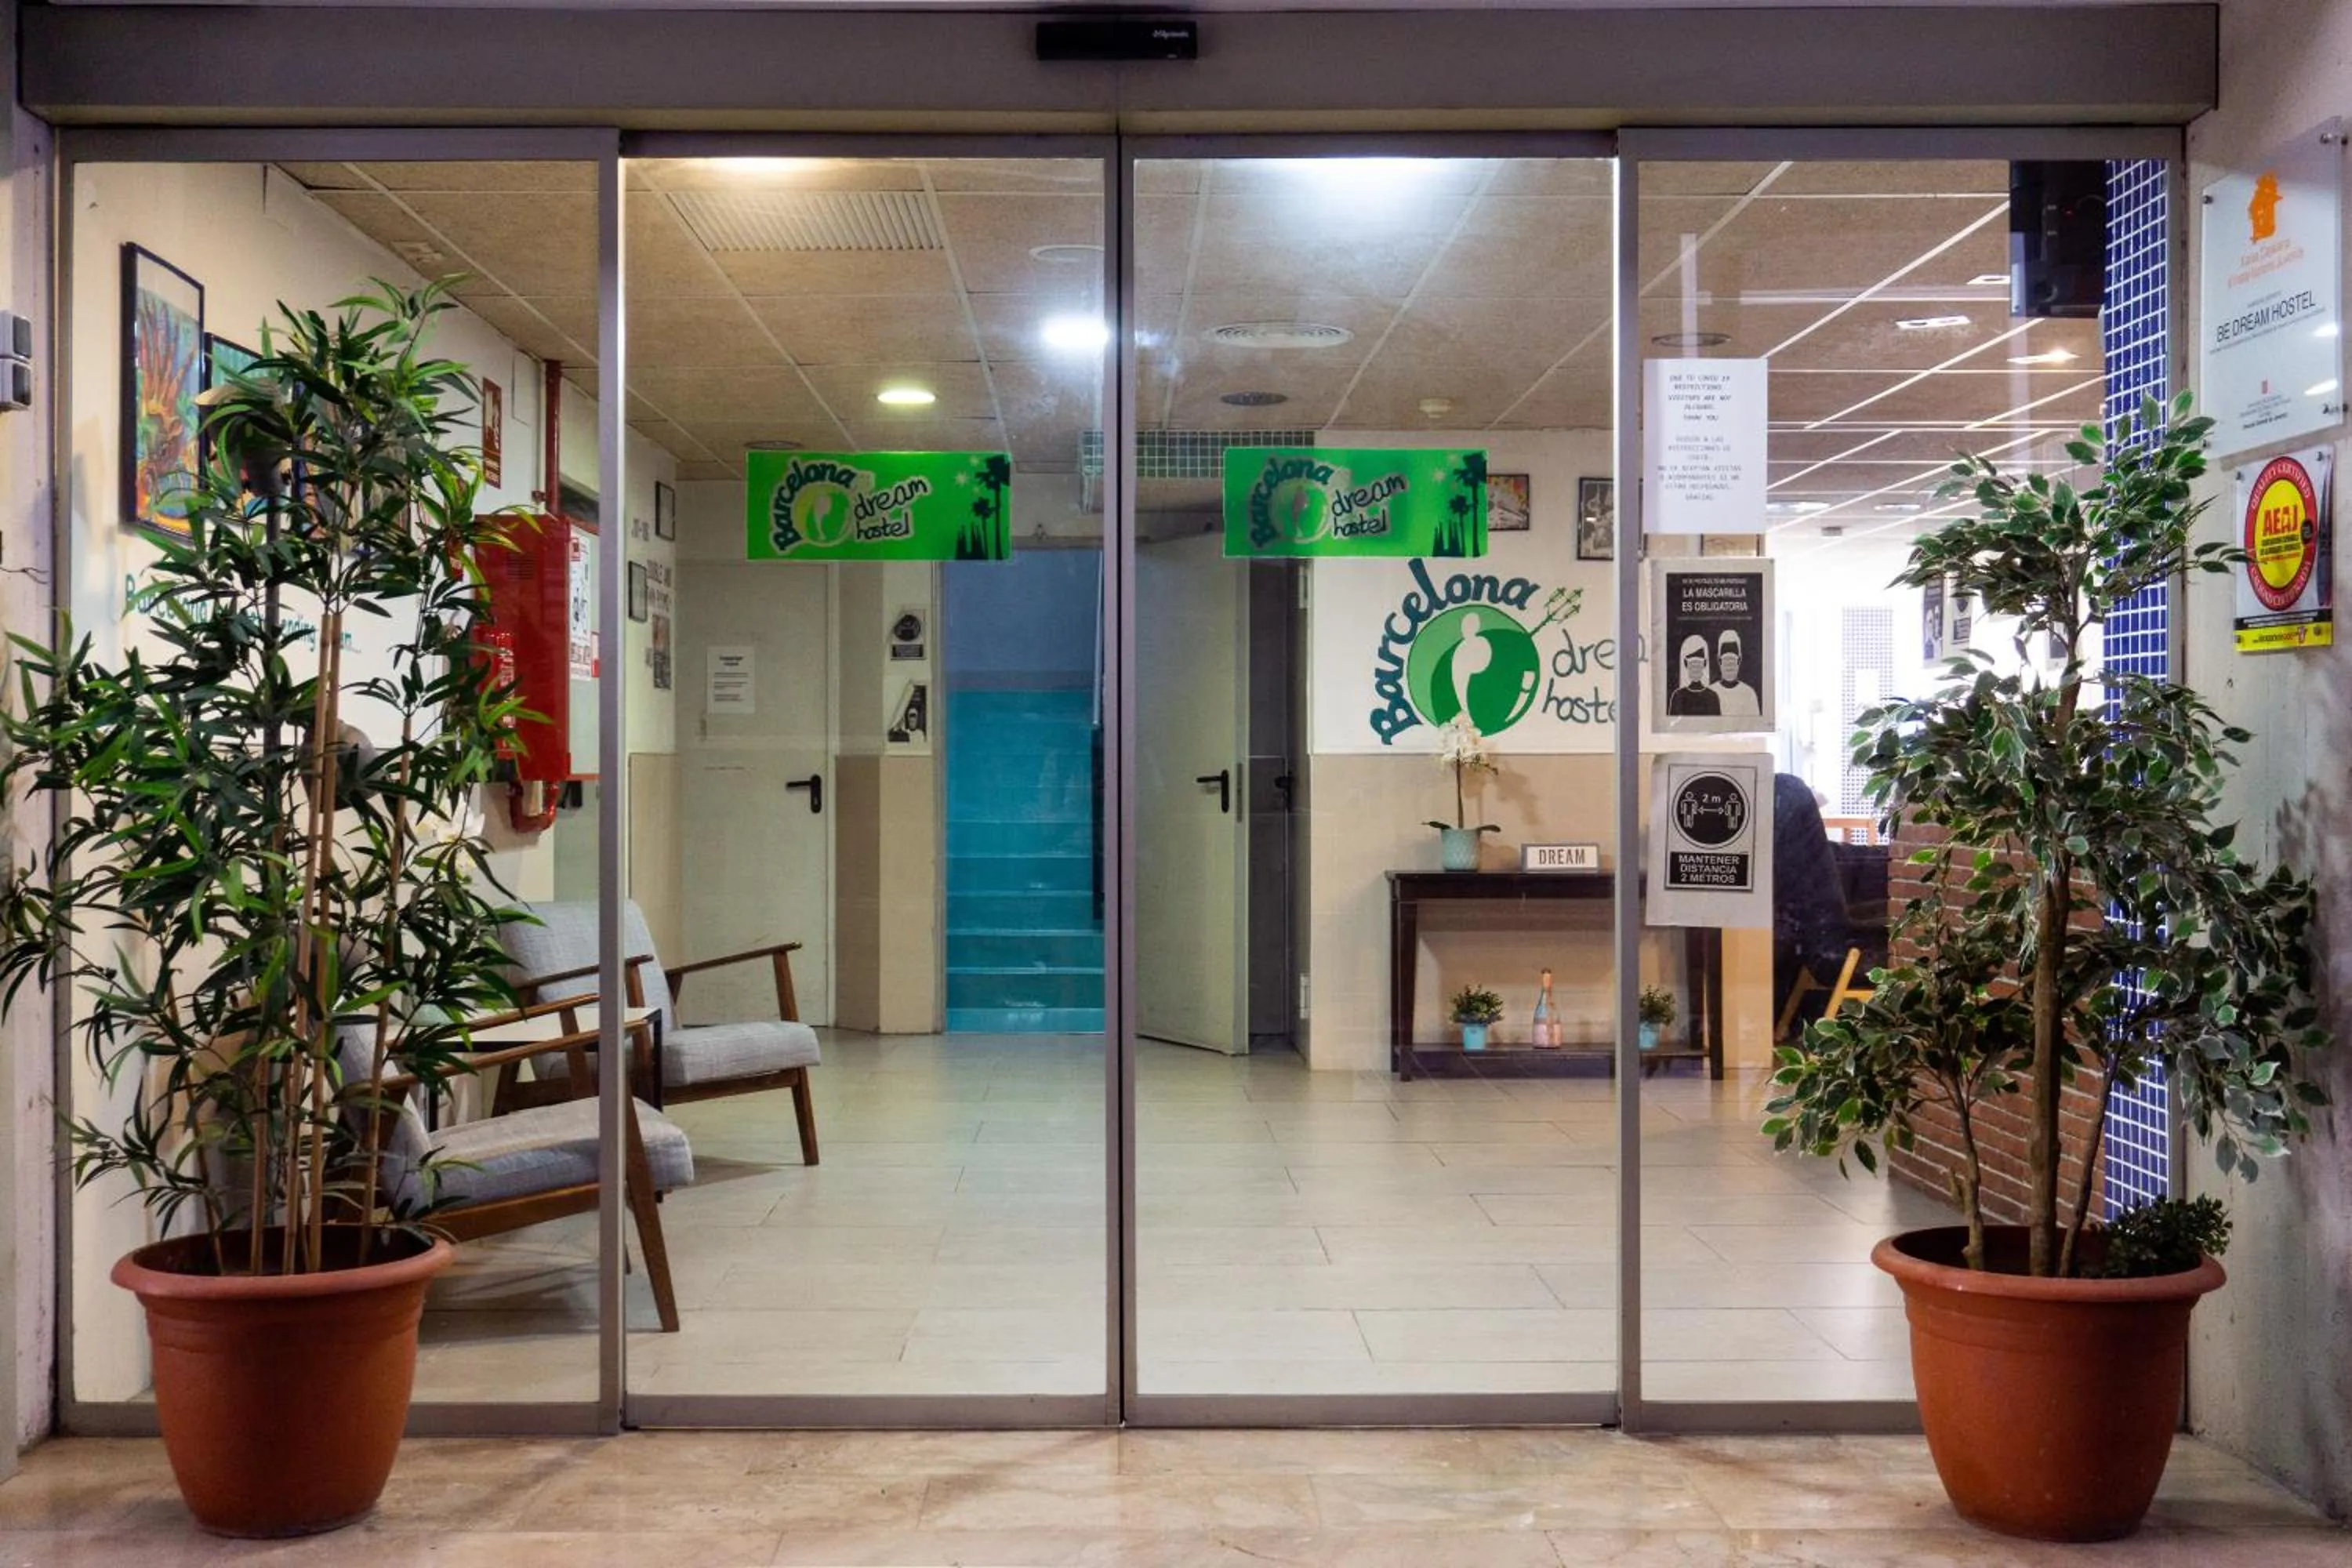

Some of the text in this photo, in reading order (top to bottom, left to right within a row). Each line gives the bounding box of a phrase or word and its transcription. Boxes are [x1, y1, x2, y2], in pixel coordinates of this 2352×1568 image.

[2216, 321, 2231, 343] BE
[2232, 307, 2270, 337] DREAM
[2271, 289, 2316, 321] HOSTEL
[773, 460, 857, 551] Barcelona
[854, 478, 928, 521] dream
[1250, 457, 1335, 547] Barcelona
[1330, 475, 1406, 517] dream
[856, 511, 910, 540] hostel
[1333, 508, 1387, 537] hostel
[1681, 601, 1749, 612] ES OBLIGATORIA
[1682, 587, 1748, 598] LA MASCARILLA
[1369, 557, 1541, 746] Barcelona
[1541, 677, 1616, 724] host
[1701, 793, 1722, 804] 2 m
[1538, 848, 1586, 866] DREAM
[1678, 854, 1740, 866] MANTENER
[1679, 864, 1738, 874] DISTANCIA
[1680, 873, 1736, 884] 2 METROS
